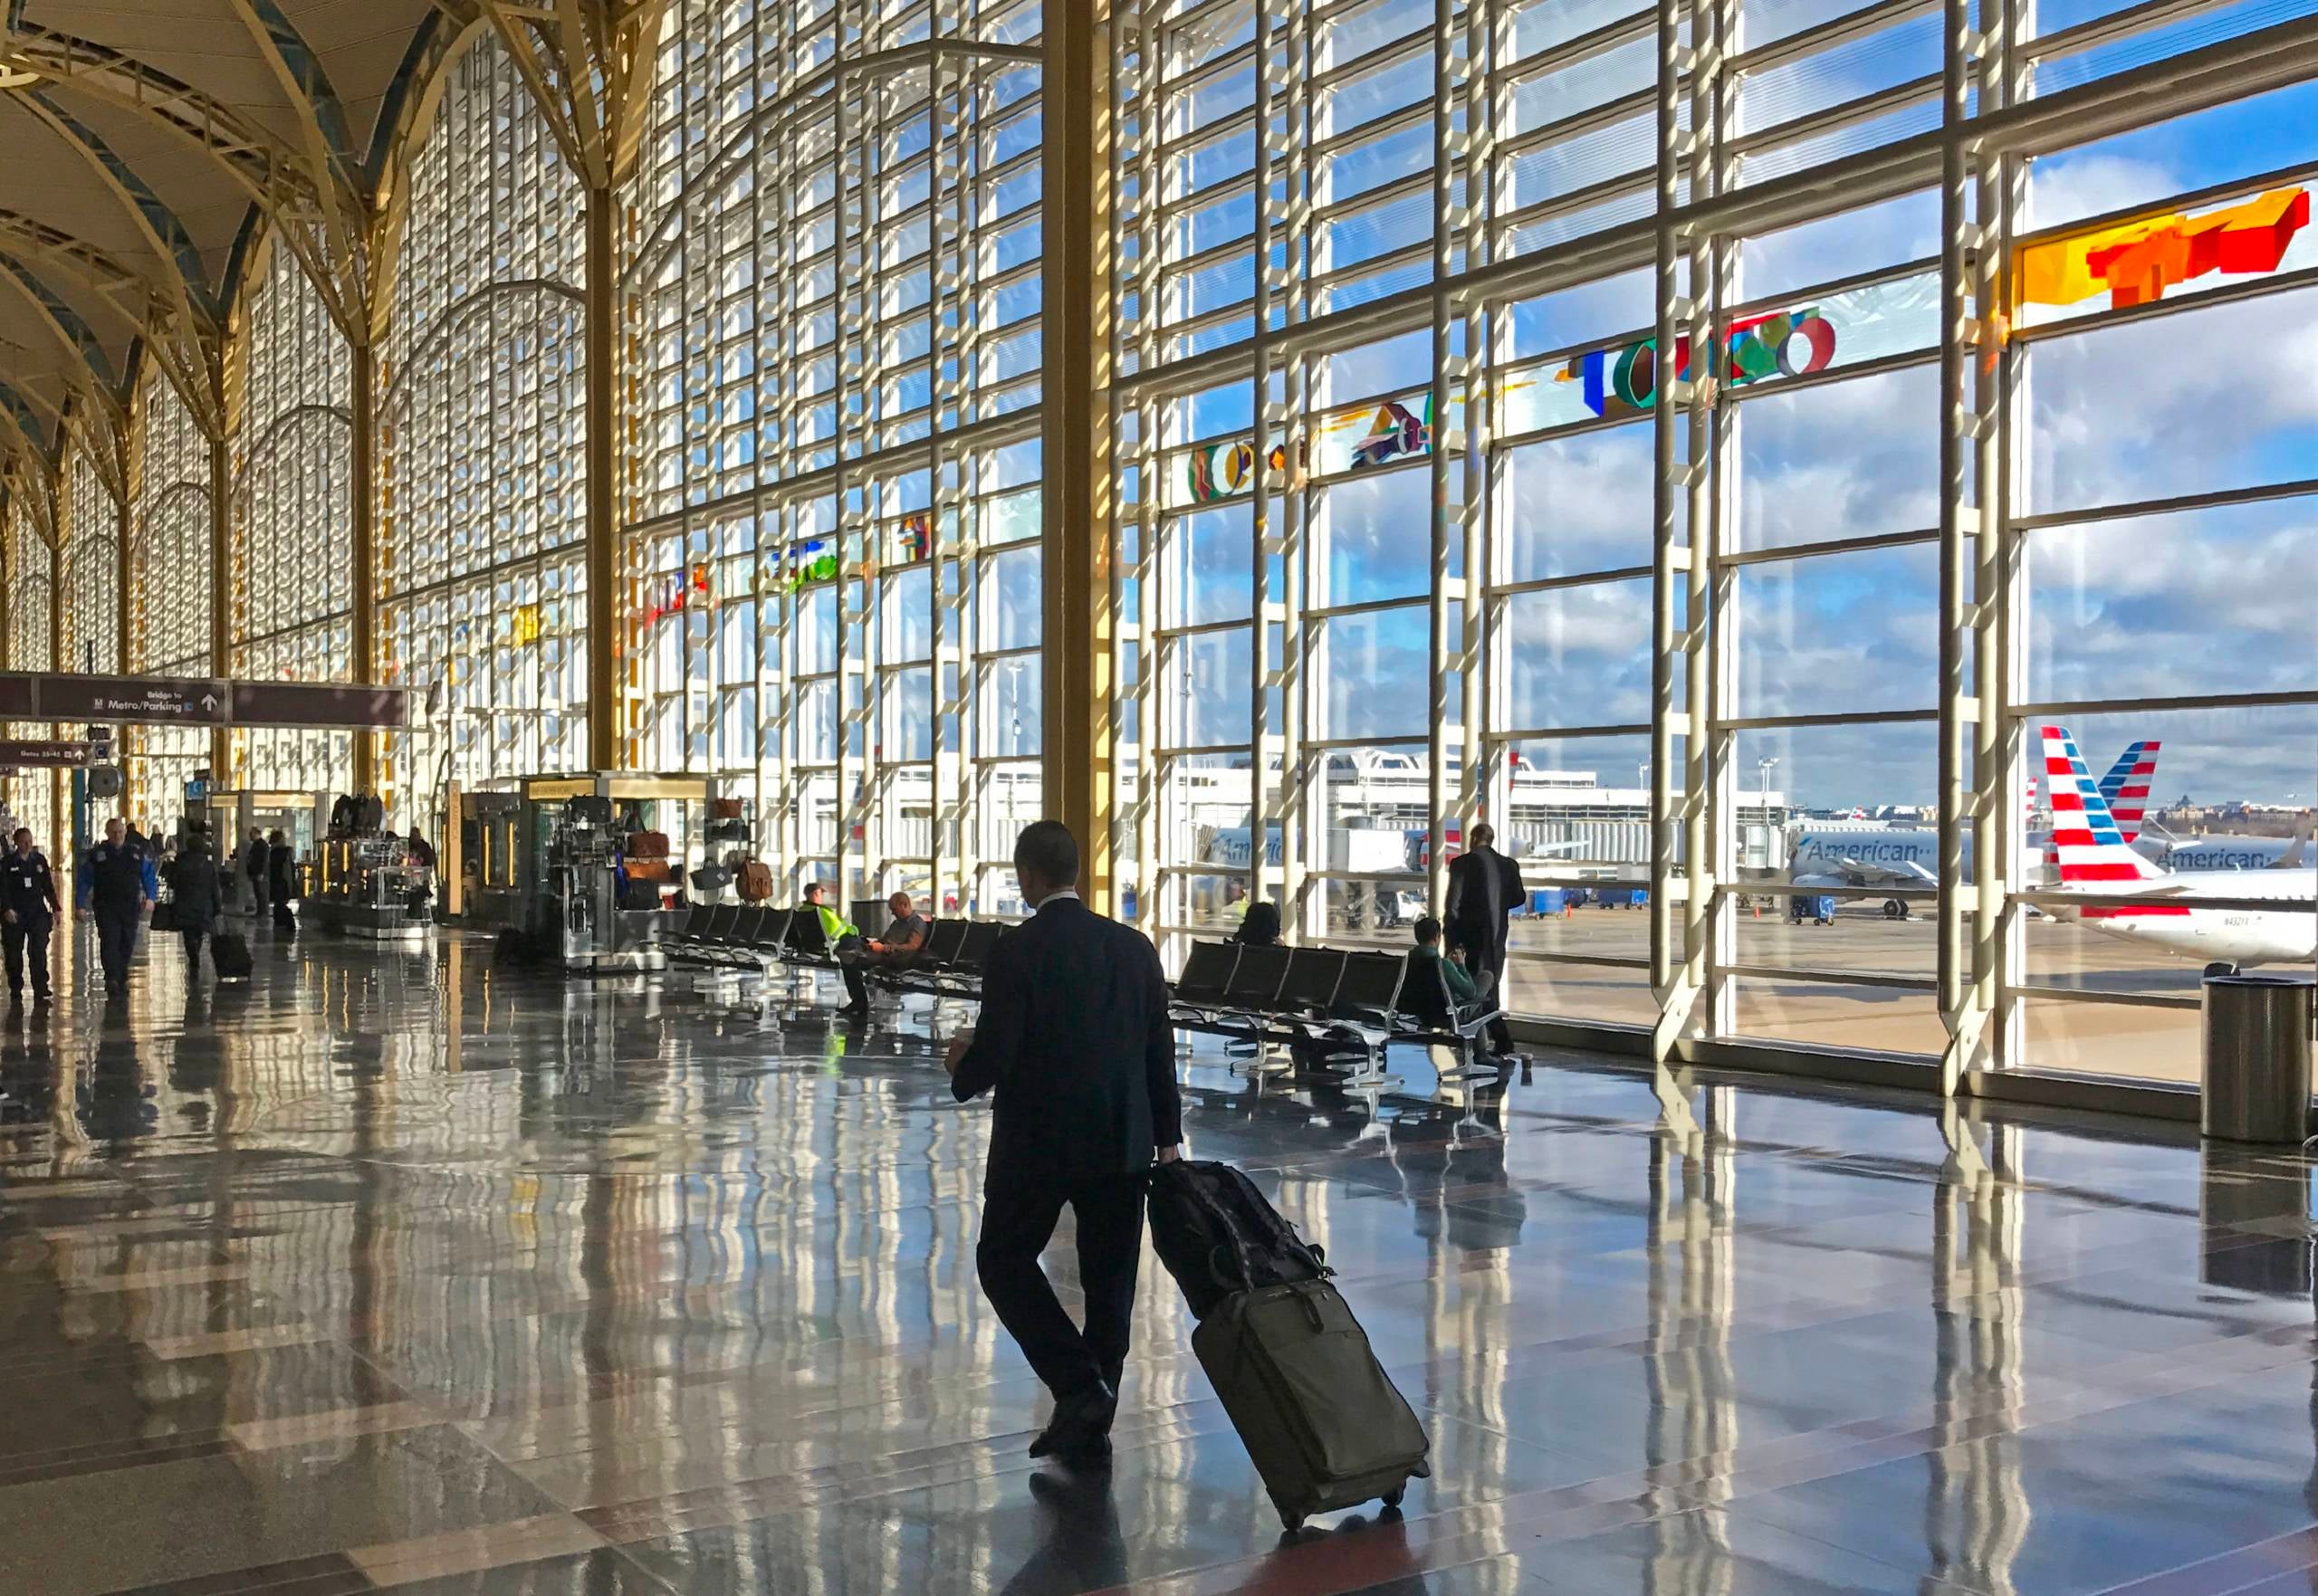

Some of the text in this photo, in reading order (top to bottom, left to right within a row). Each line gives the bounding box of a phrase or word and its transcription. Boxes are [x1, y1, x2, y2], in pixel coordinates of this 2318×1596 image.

[148, 691, 182, 701] Bridge to
[108, 700, 182, 713] Metro/Parking
[1807, 840, 1918, 861] American
[2156, 848, 2264, 868] American
